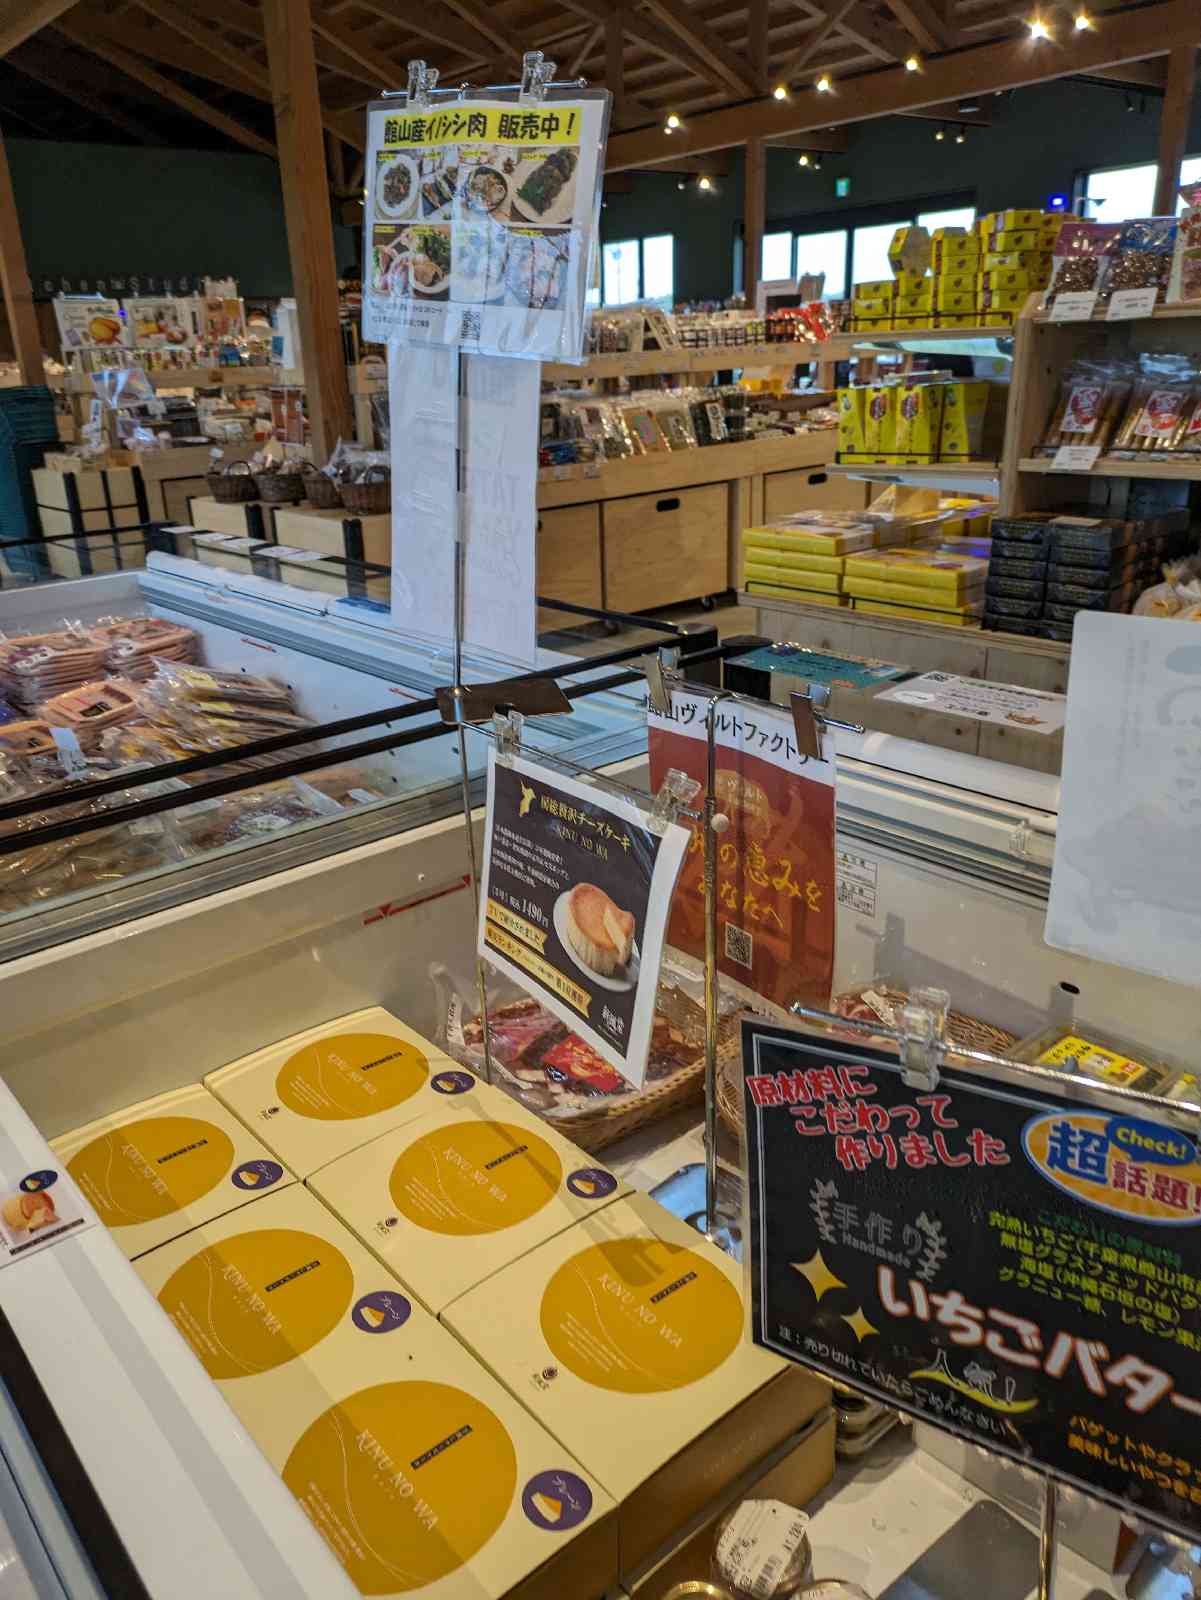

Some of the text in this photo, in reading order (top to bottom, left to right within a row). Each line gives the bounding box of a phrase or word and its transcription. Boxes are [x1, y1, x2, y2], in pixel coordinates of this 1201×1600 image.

[384, 112, 488, 144] 館山産イノシシ肉
[745, 1065, 878, 1107] 原材料に
[789, 1094, 959, 1136] こだわって
[834, 1128, 1010, 1171] 作りました
[1046, 1119, 1112, 1186] 超
[1115, 1126, 1188, 1160] Check!
[832, 1200, 923, 1256] 手作り
[841, 1231, 913, 1268] Handmade
